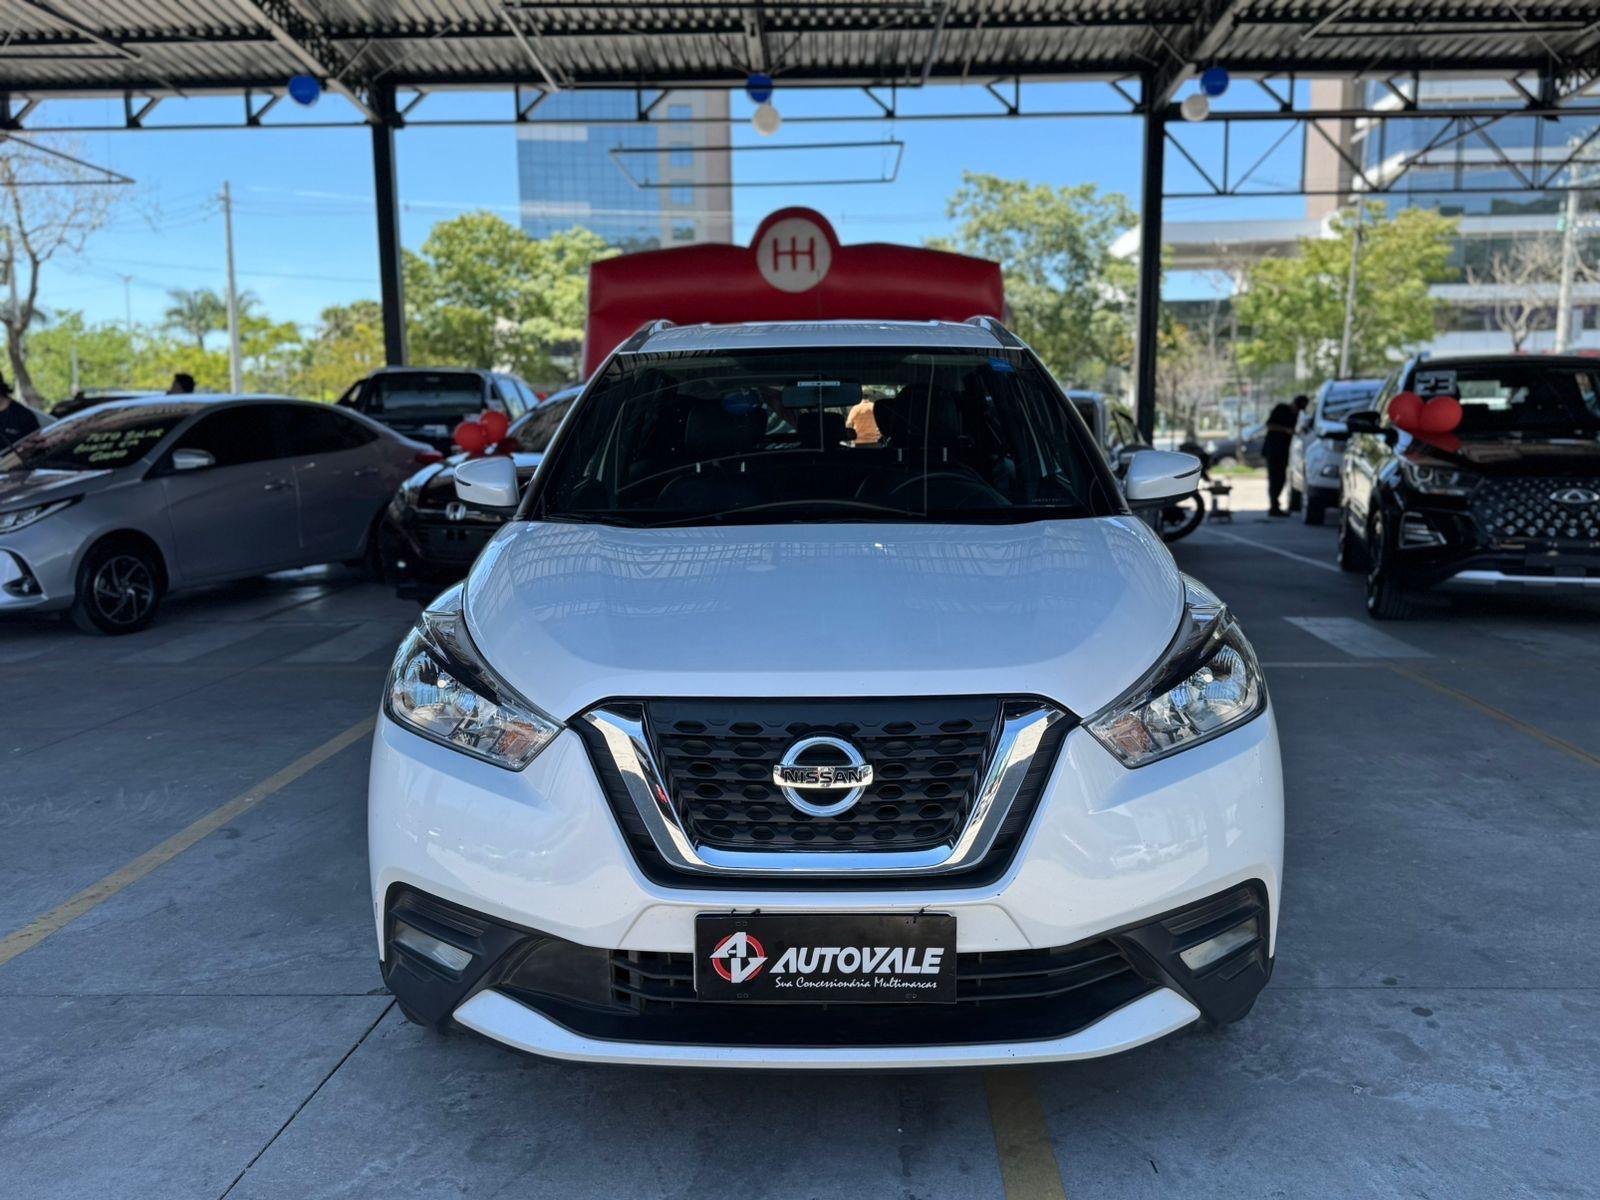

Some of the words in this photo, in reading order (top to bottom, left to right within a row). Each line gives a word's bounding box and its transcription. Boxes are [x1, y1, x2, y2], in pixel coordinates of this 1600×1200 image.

[783, 769, 863, 784] NISSAN
[769, 947, 945, 974] AUTOVALE
[775, 976, 793, 988] Sua
[795, 976, 871, 989] Concessionária
[874, 976, 937, 989] Multimarcas
